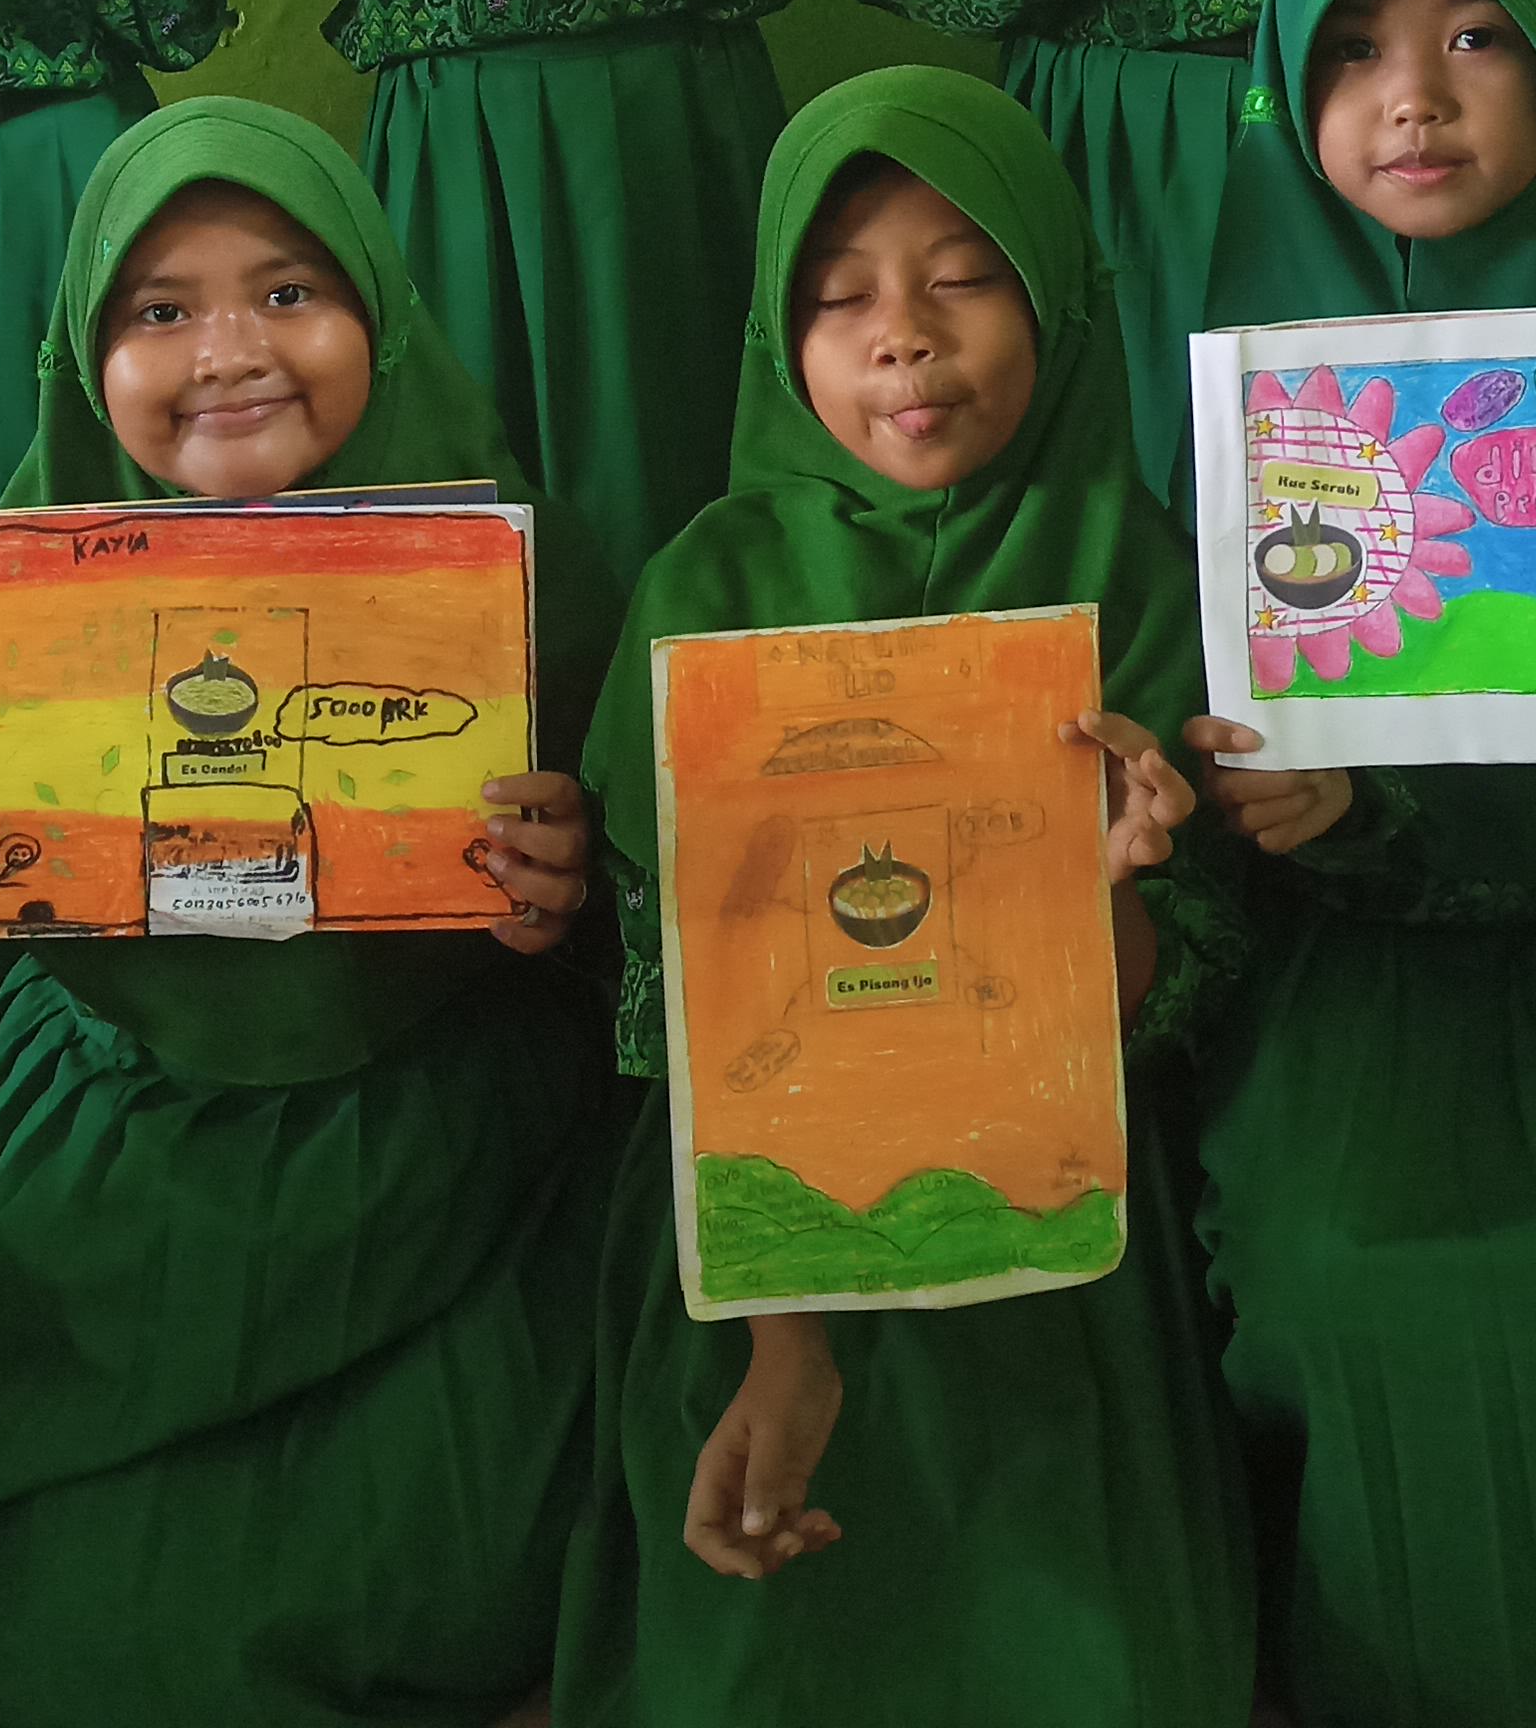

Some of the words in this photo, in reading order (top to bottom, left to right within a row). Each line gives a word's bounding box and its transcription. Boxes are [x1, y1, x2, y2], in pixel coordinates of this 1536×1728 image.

[1277, 475, 1307, 490] Kue
[1309, 479, 1361, 497] Serabi
[308, 696, 377, 721] 5000
[181, 764, 198, 775] Es
[201, 763, 249, 775] Cendol
[836, 980, 856, 993] Es
[859, 976, 910, 991] Pisang
[912, 974, 933, 988] Ijo
